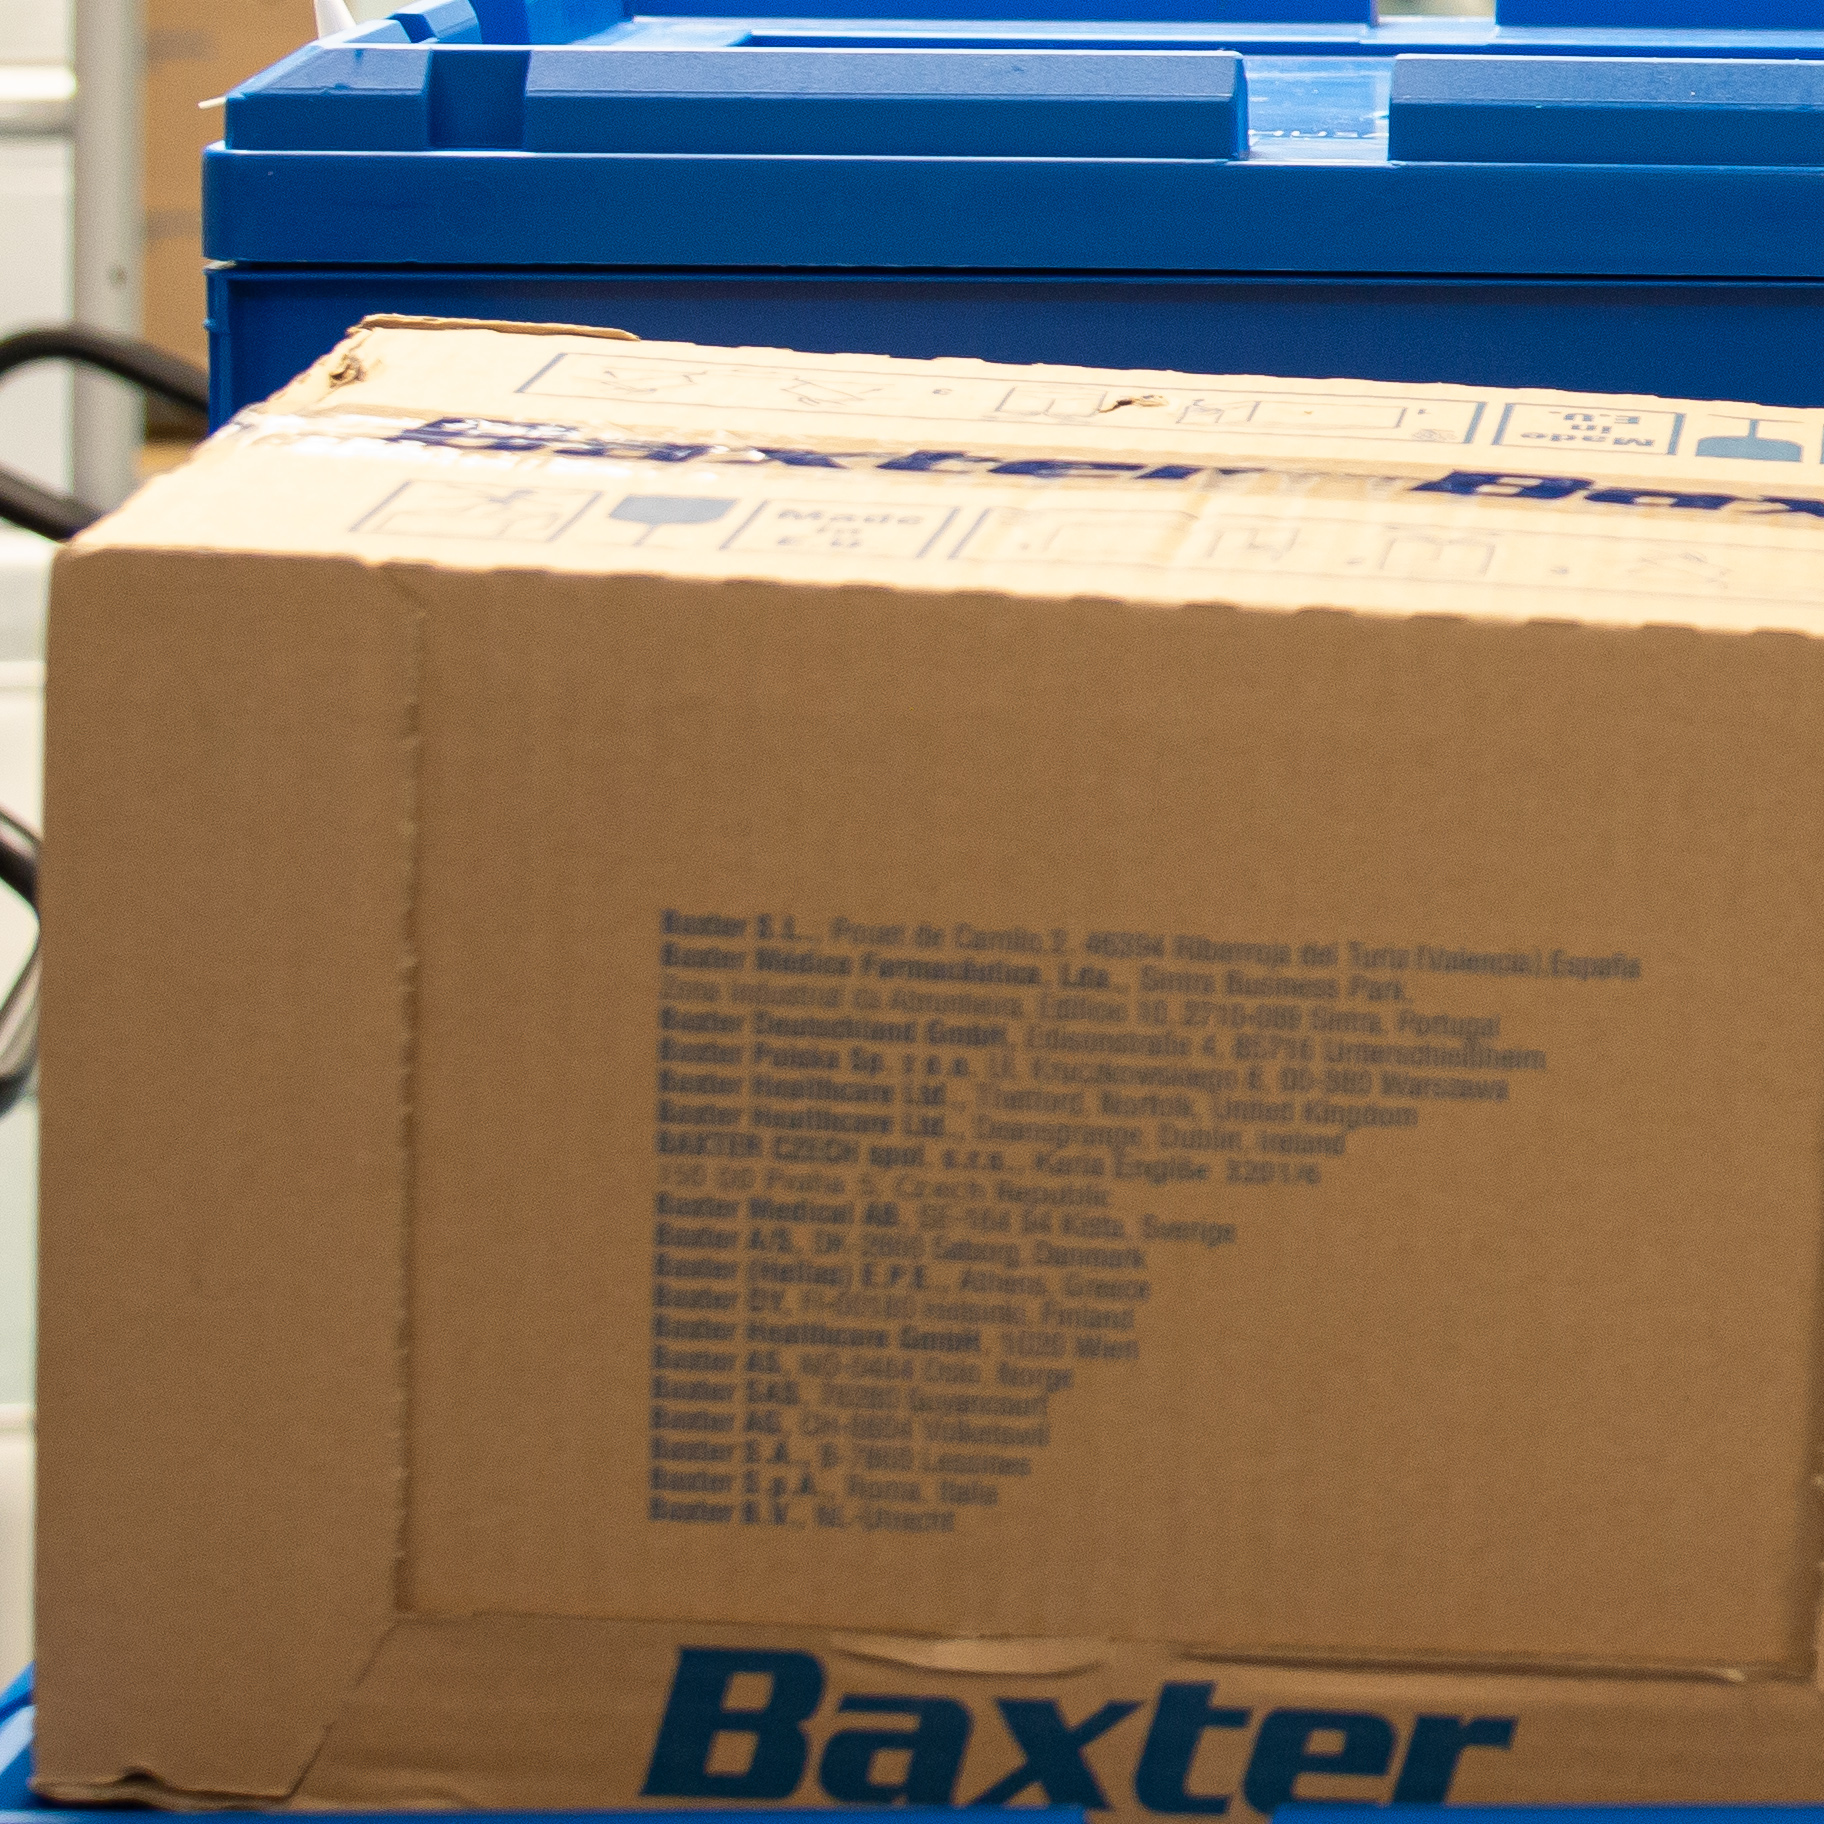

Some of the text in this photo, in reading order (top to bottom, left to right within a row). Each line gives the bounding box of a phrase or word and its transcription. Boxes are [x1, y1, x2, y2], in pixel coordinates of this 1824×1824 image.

[386, 417, 1268, 479] Baxter
[1520, 431, 1655, 448] Made
[777, 508, 925, 526] Made
[660, 911, 745, 938] Baxter
[659, 945, 743, 972] Baxter
[1223, 971, 1339, 1000] Business
[658, 1009, 742, 1036] Baxter
[1396, 1012, 1503, 1045] Portugal
[657, 1040, 741, 1067] Baxter
[657, 1071, 741, 1098] Baxter
[751, 1075, 895, 1105] Healthcare
[1210, 1097, 1295, 1124] United
[1301, 1101, 1420, 1134] Kingdom
[656, 1102, 740, 1129] Baxter
[750, 1106, 894, 1136] Healthcare
[654, 1195, 738, 1222] Baxter
[654, 1226, 738, 1253] Baxter
[653, 1256, 737, 1283] Baxter
[652, 1286, 736, 1313] Baxter
[652, 1317, 736, 1344] Baxter
[746, 1321, 890, 1350] Healthcare
[651, 1348, 735, 1375] Baxter
[650, 1378, 734, 1405] Baxter
[650, 1409, 734, 1436] Baxter
[649, 1439, 733, 1466] Baxter
[649, 1470, 733, 1497] Baxter
[648, 1500, 732, 1527] Baxter
[638, 1646, 1518, 1816] Baxter
